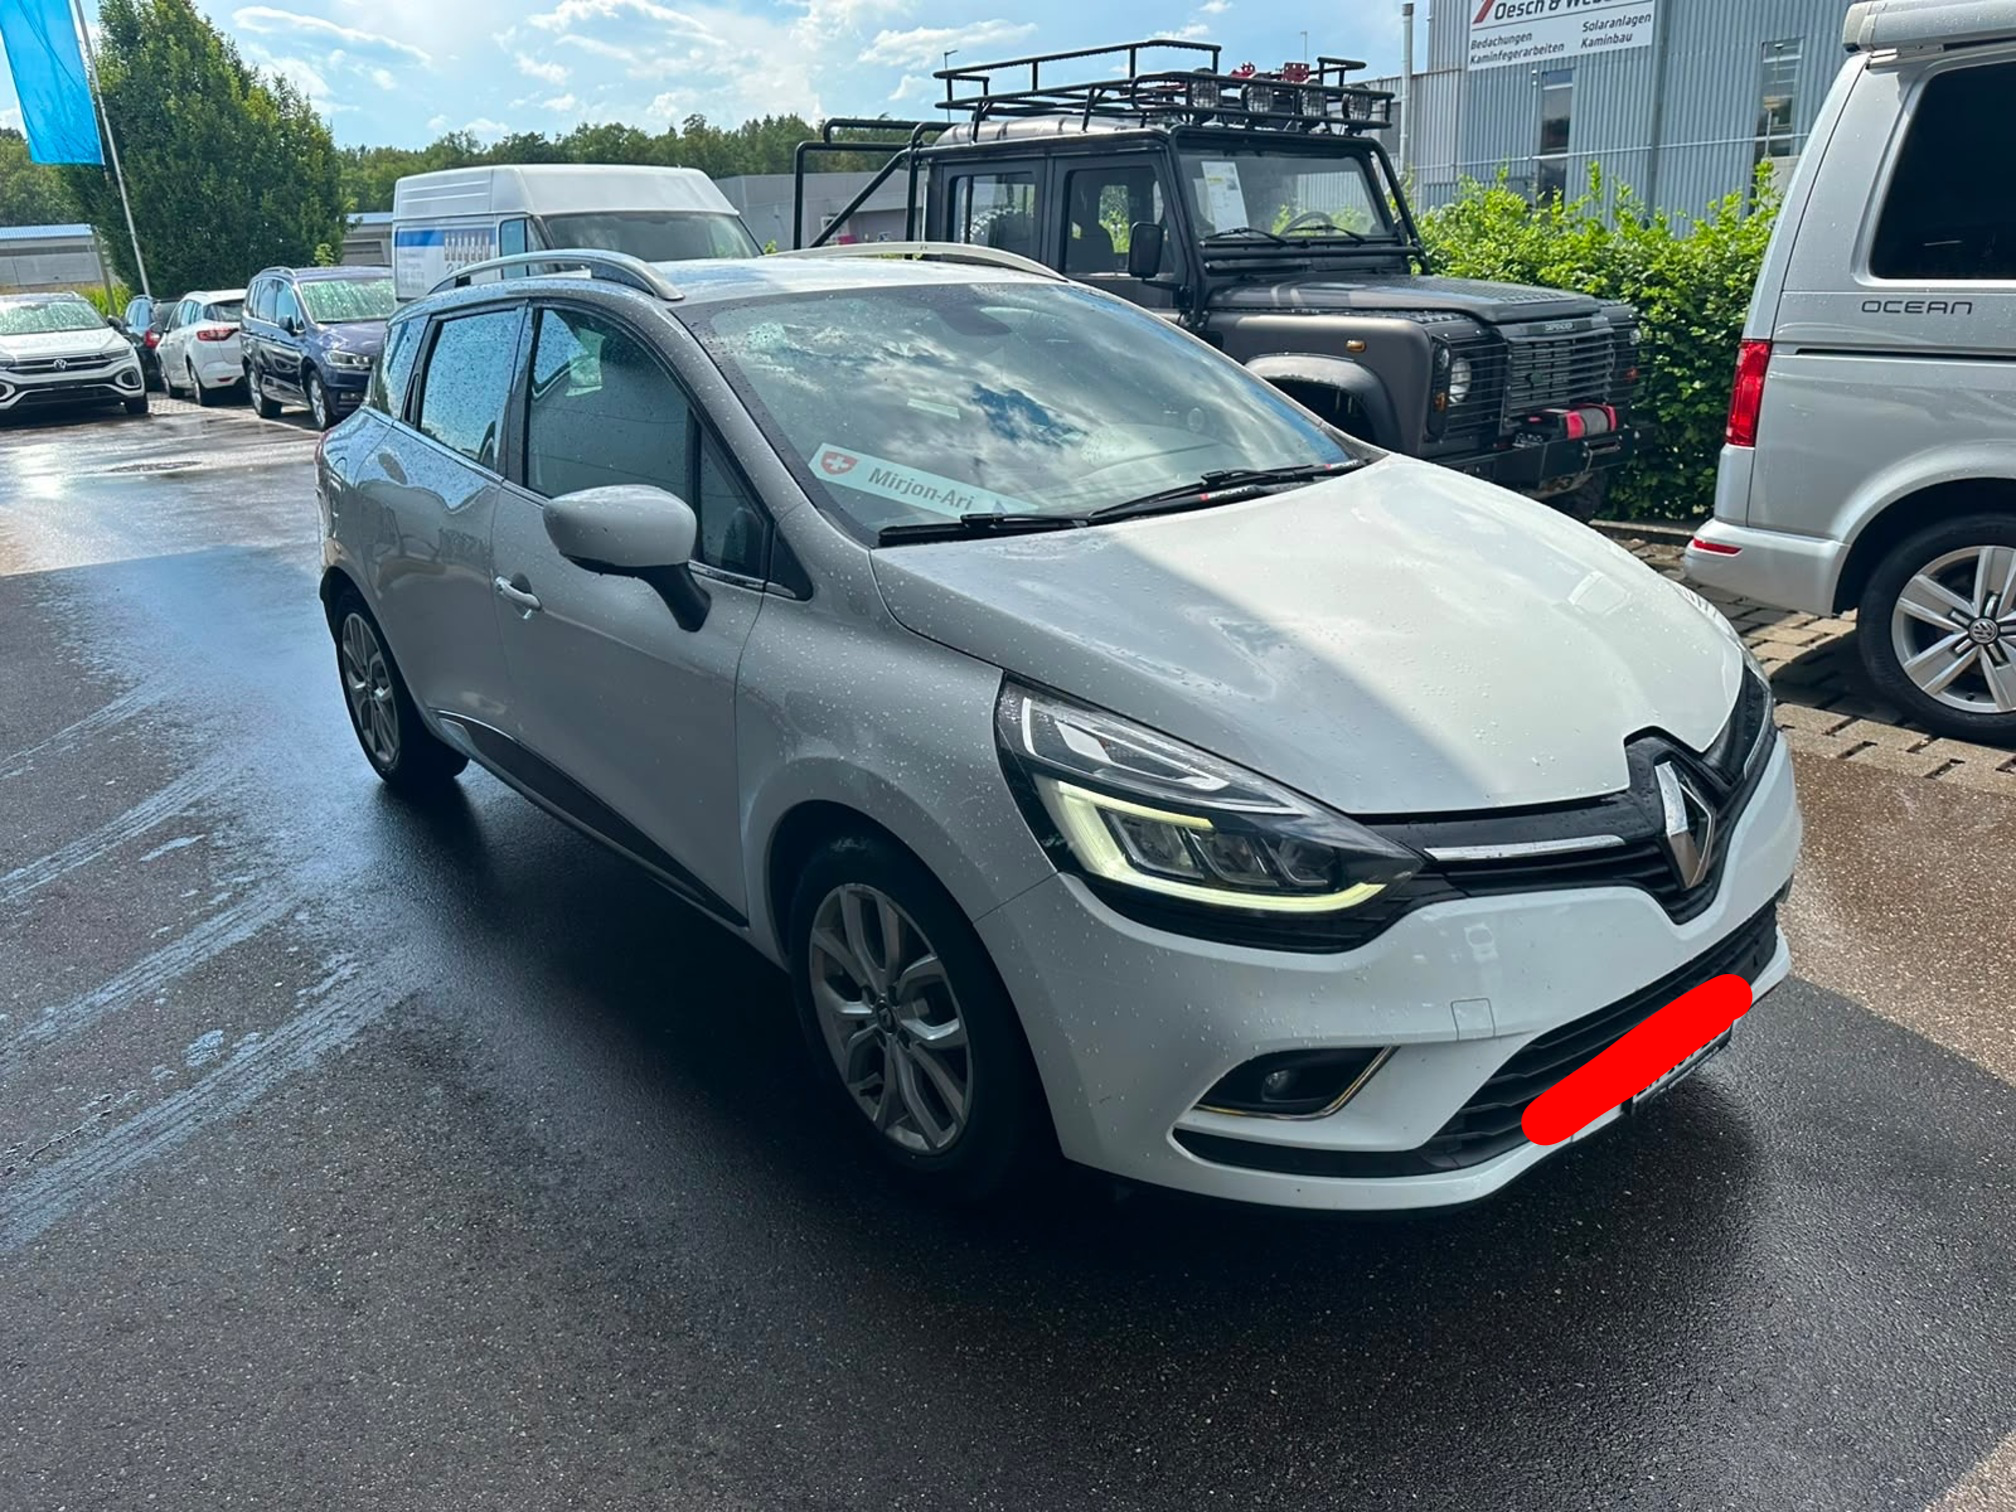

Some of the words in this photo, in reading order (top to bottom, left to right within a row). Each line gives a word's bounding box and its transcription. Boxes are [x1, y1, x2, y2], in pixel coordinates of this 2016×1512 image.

[1495, 0, 1544, 20] Oesch
[1582, 13, 1651, 32] Solaranlagen
[1470, 32, 1532, 50] Bedachungen
[1580, 32, 1633, 49] Kaminbau
[1470, 42, 1564, 64] Kaminfegerarbeiten
[1861, 300, 1973, 315] OCEAN
[869, 468, 975, 511] Mirjon-Ari
